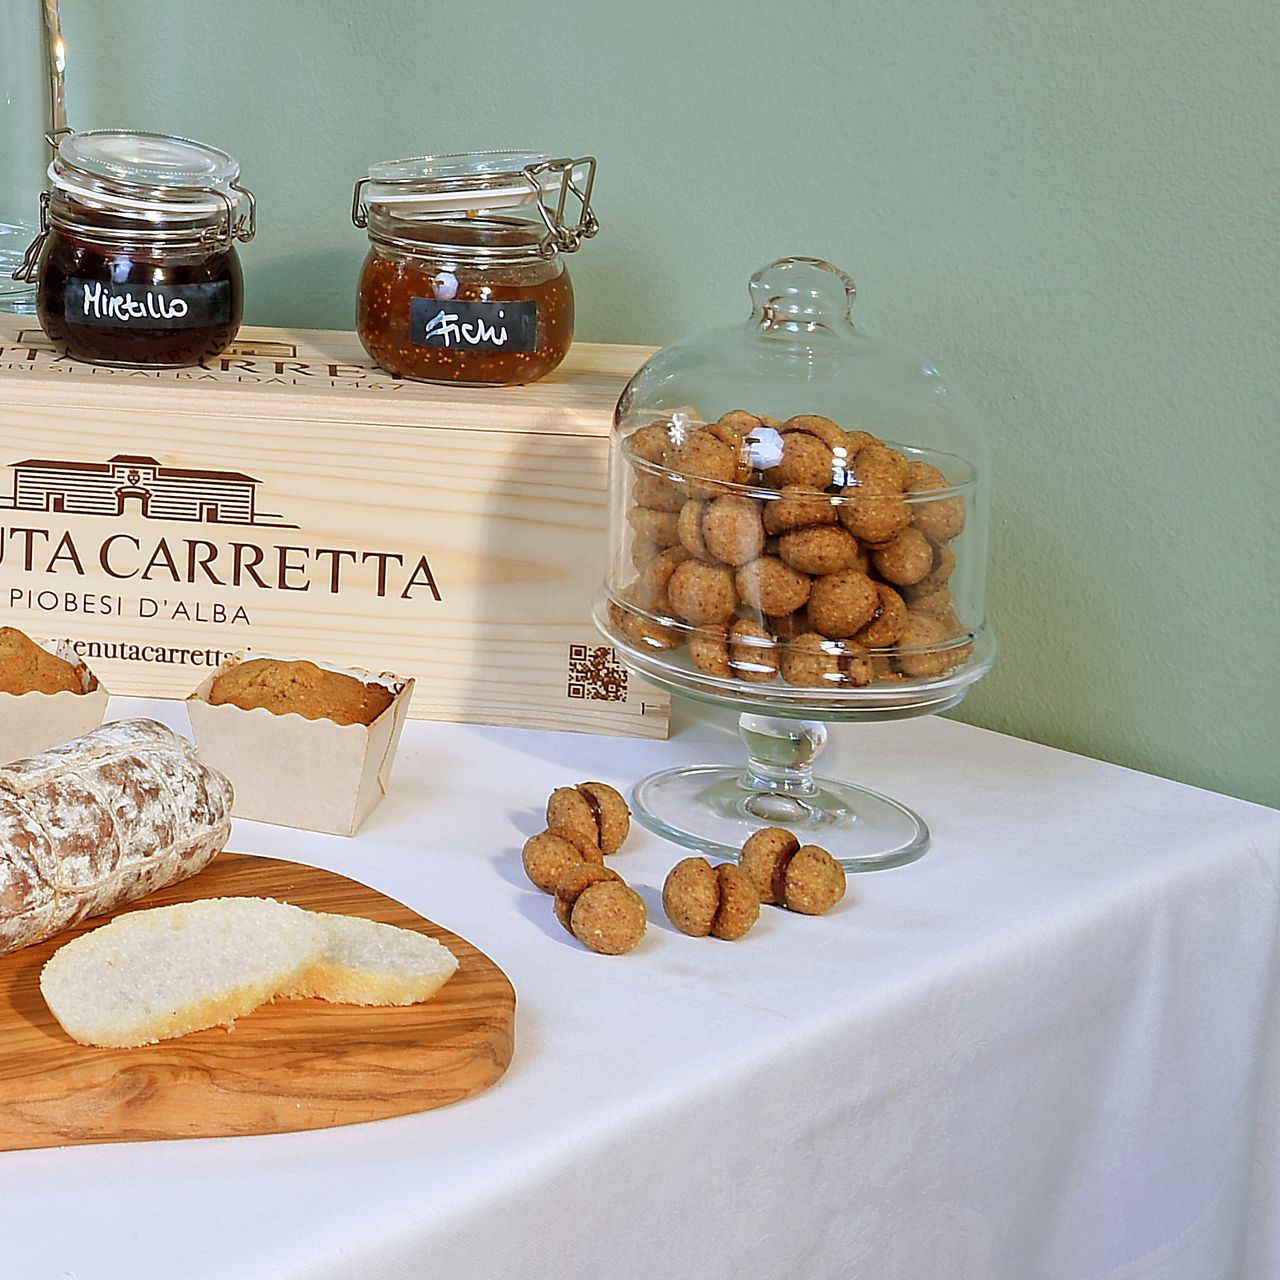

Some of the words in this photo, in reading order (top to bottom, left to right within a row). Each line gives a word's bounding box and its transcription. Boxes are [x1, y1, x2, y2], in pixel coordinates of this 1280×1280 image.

[83, 281, 190, 321] Mirtillo
[425, 310, 509, 347] Fichi
[98, 532, 443, 603] CARRETTA
[9, 587, 123, 617] PIOBESI
[139, 597, 252, 626] D'ALBA
